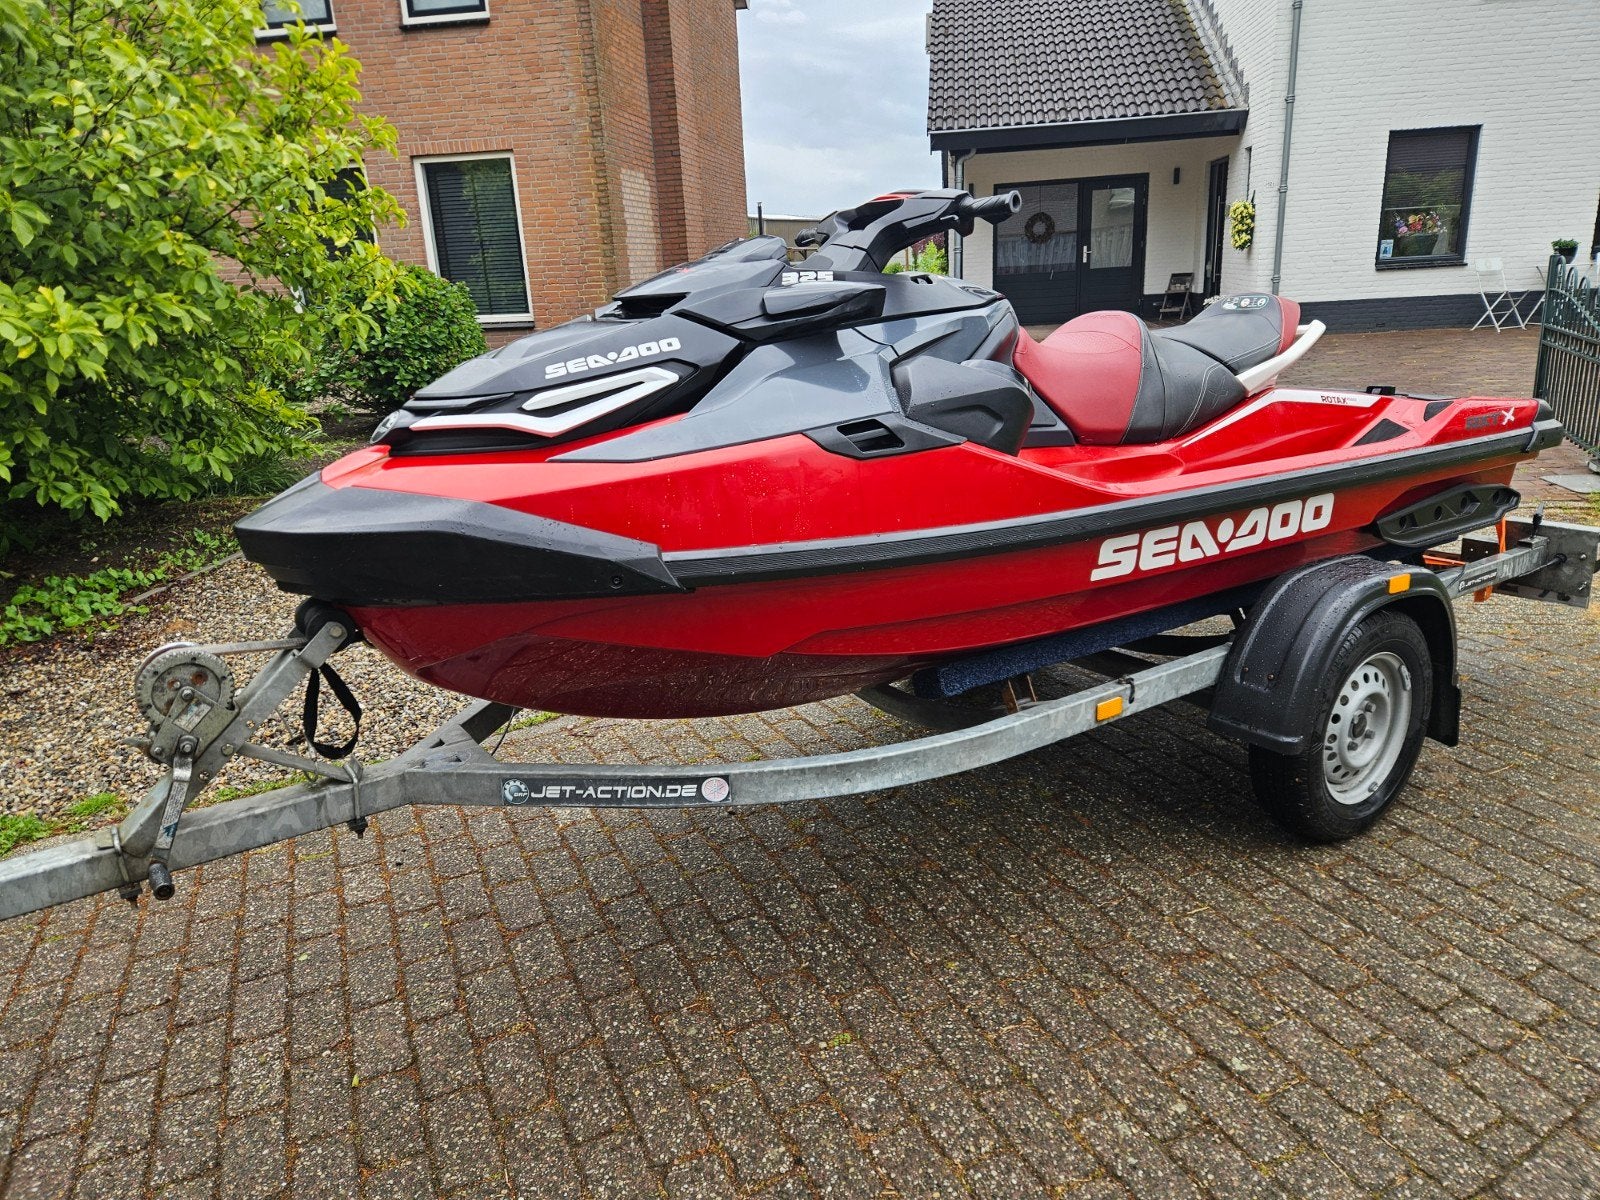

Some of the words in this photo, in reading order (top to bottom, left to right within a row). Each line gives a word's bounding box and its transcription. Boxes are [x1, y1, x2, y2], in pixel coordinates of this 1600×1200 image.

[781, 270, 834, 286] 325
[1320, 395, 1347, 405] ROTAX
[530, 784, 698, 798] JET-ACTION.DE
